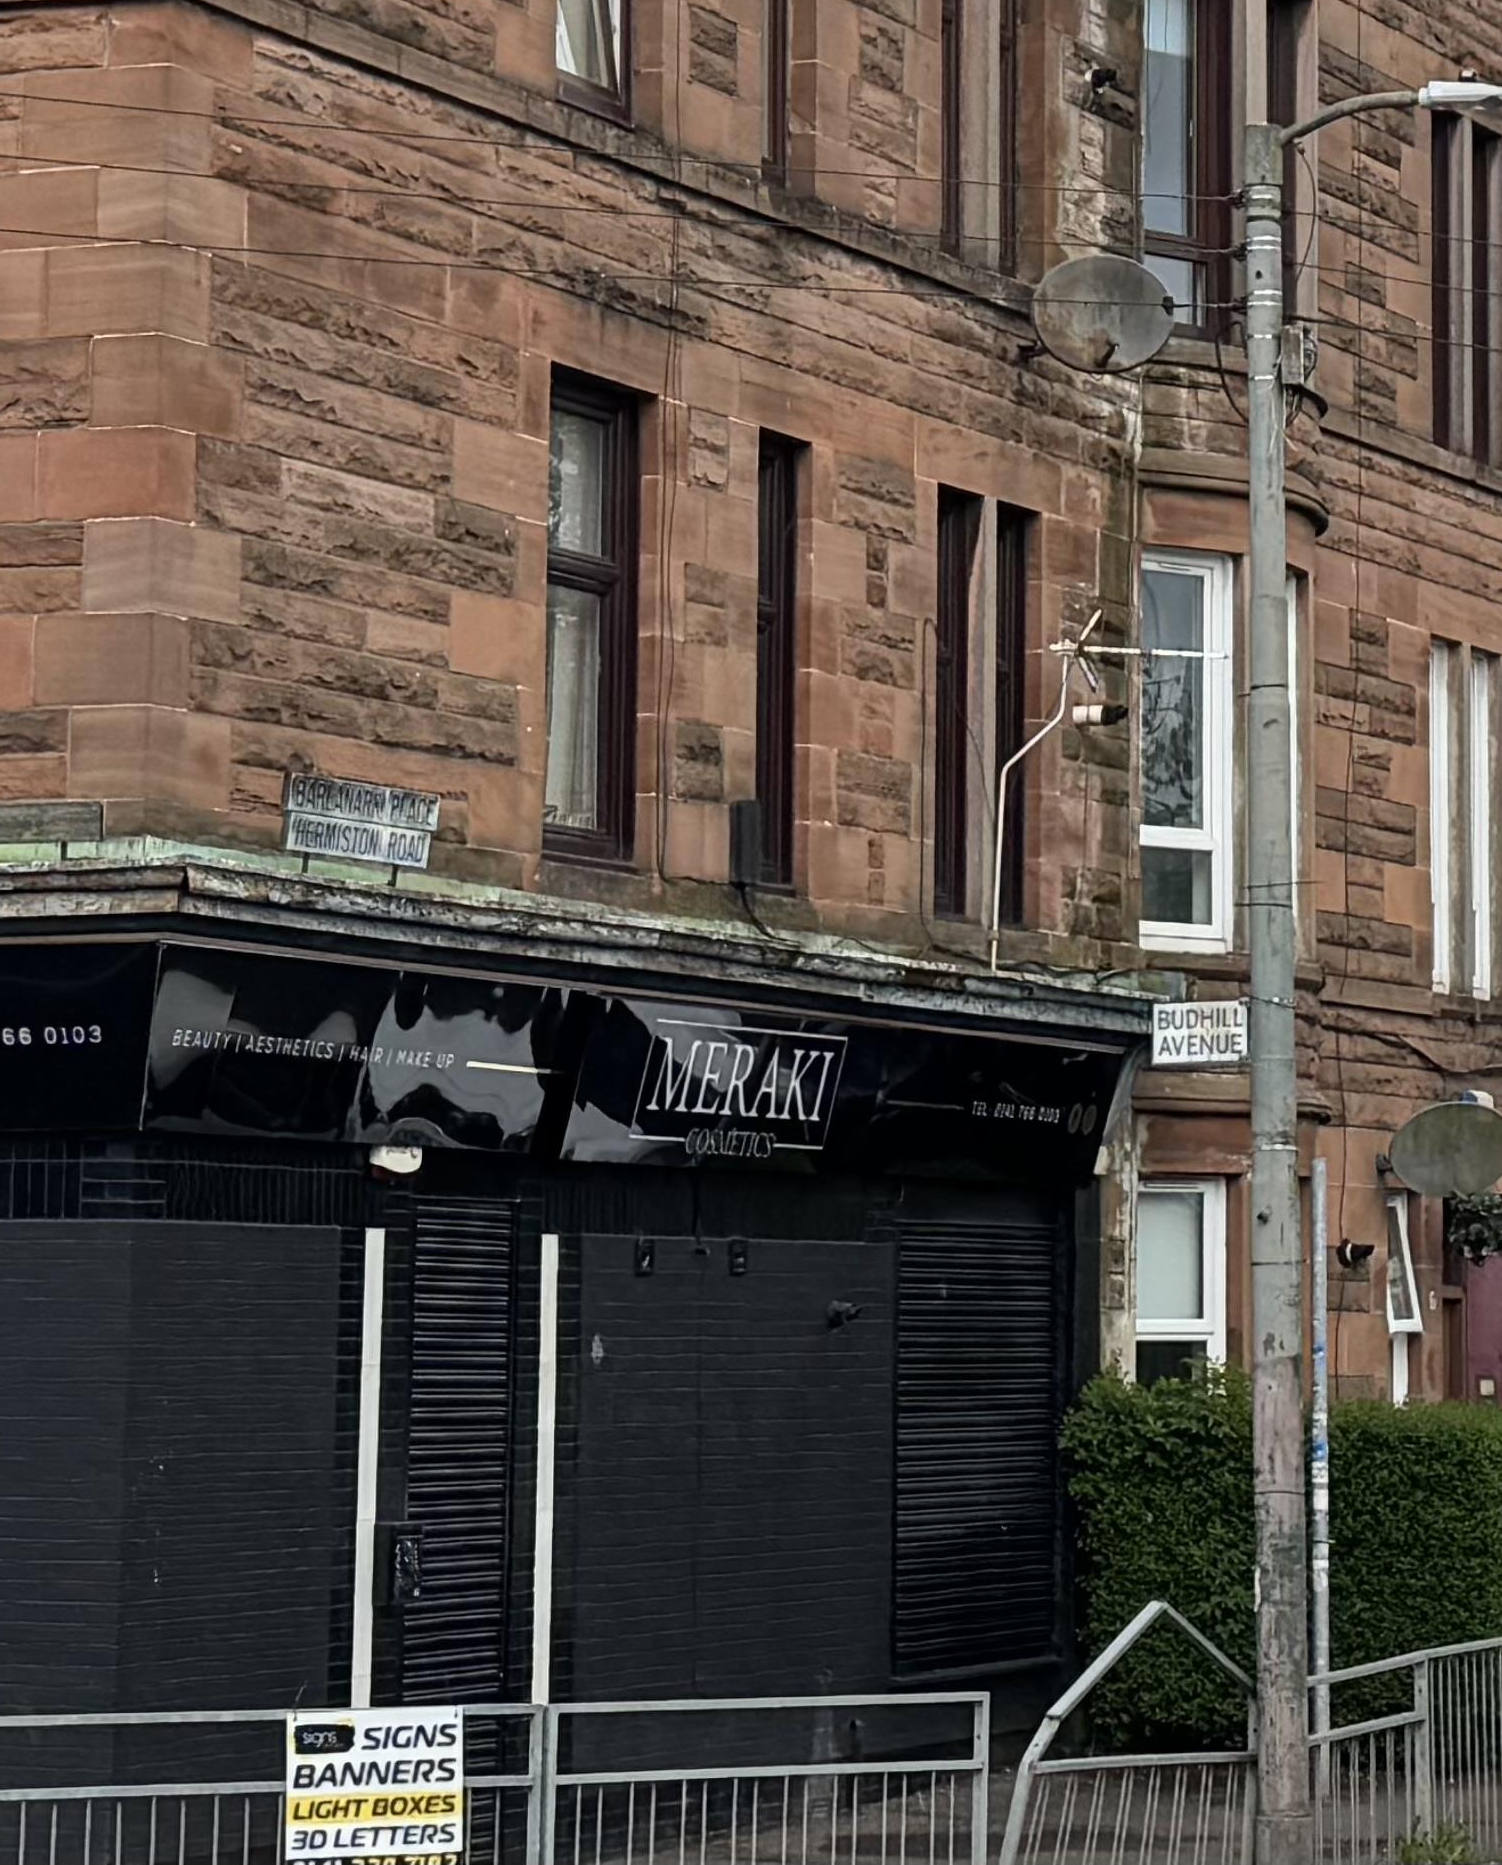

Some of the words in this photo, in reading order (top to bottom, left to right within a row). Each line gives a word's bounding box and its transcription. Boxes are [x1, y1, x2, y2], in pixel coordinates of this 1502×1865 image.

[389, 791, 438, 826] PLACE
[292, 817, 379, 855] HERMISTON
[387, 831, 426, 863] ROAD
[1157, 1007, 1243, 1030] BUDHILL
[44, 1025, 102, 1045] 0103
[171, 1029, 232, 1049] BEAUTY
[245, 1034, 335, 1059] AESTHETICS
[349, 1045, 383, 1063] HAIR
[395, 1049, 431, 1067] MAKE
[435, 1053, 455, 1069] UP
[1157, 1034, 1243, 1056] AVENUE
[646, 1037, 835, 1121] MERAKI
[685, 1128, 777, 1158] COSMETICS
[361, 1724, 457, 1750] SIGNS
[293, 1758, 457, 1789] BANNERS
[293, 1799, 368, 1820] LIGHT
[372, 1795, 456, 1816] BOXES
[292, 1829, 327, 1850] 3D
[333, 1823, 456, 1848] LETTERS
